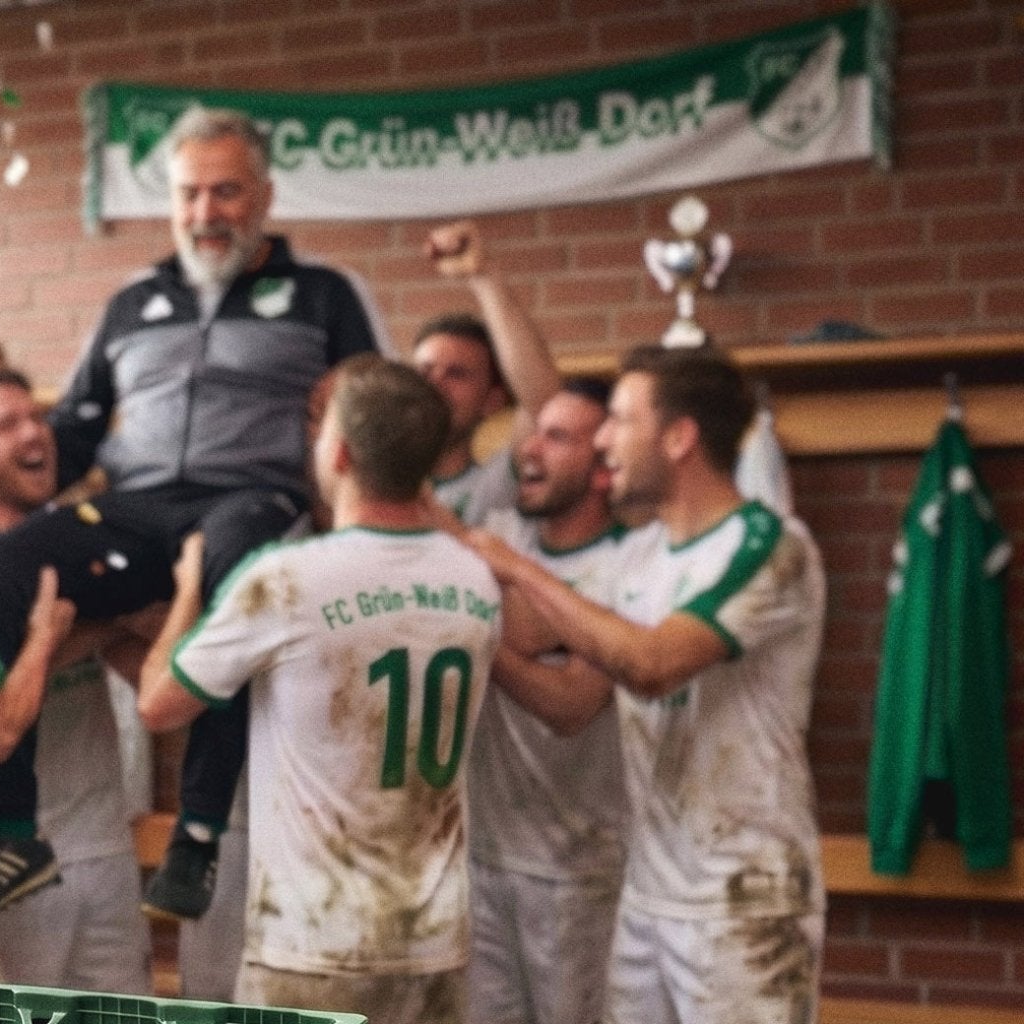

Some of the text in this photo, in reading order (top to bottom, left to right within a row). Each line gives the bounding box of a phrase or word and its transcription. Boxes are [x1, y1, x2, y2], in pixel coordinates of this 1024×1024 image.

[257, 75, 715, 171] C Grün-Weiß Dorf
[321, 598, 353, 630] FC
[367, 646, 472, 790] 10
